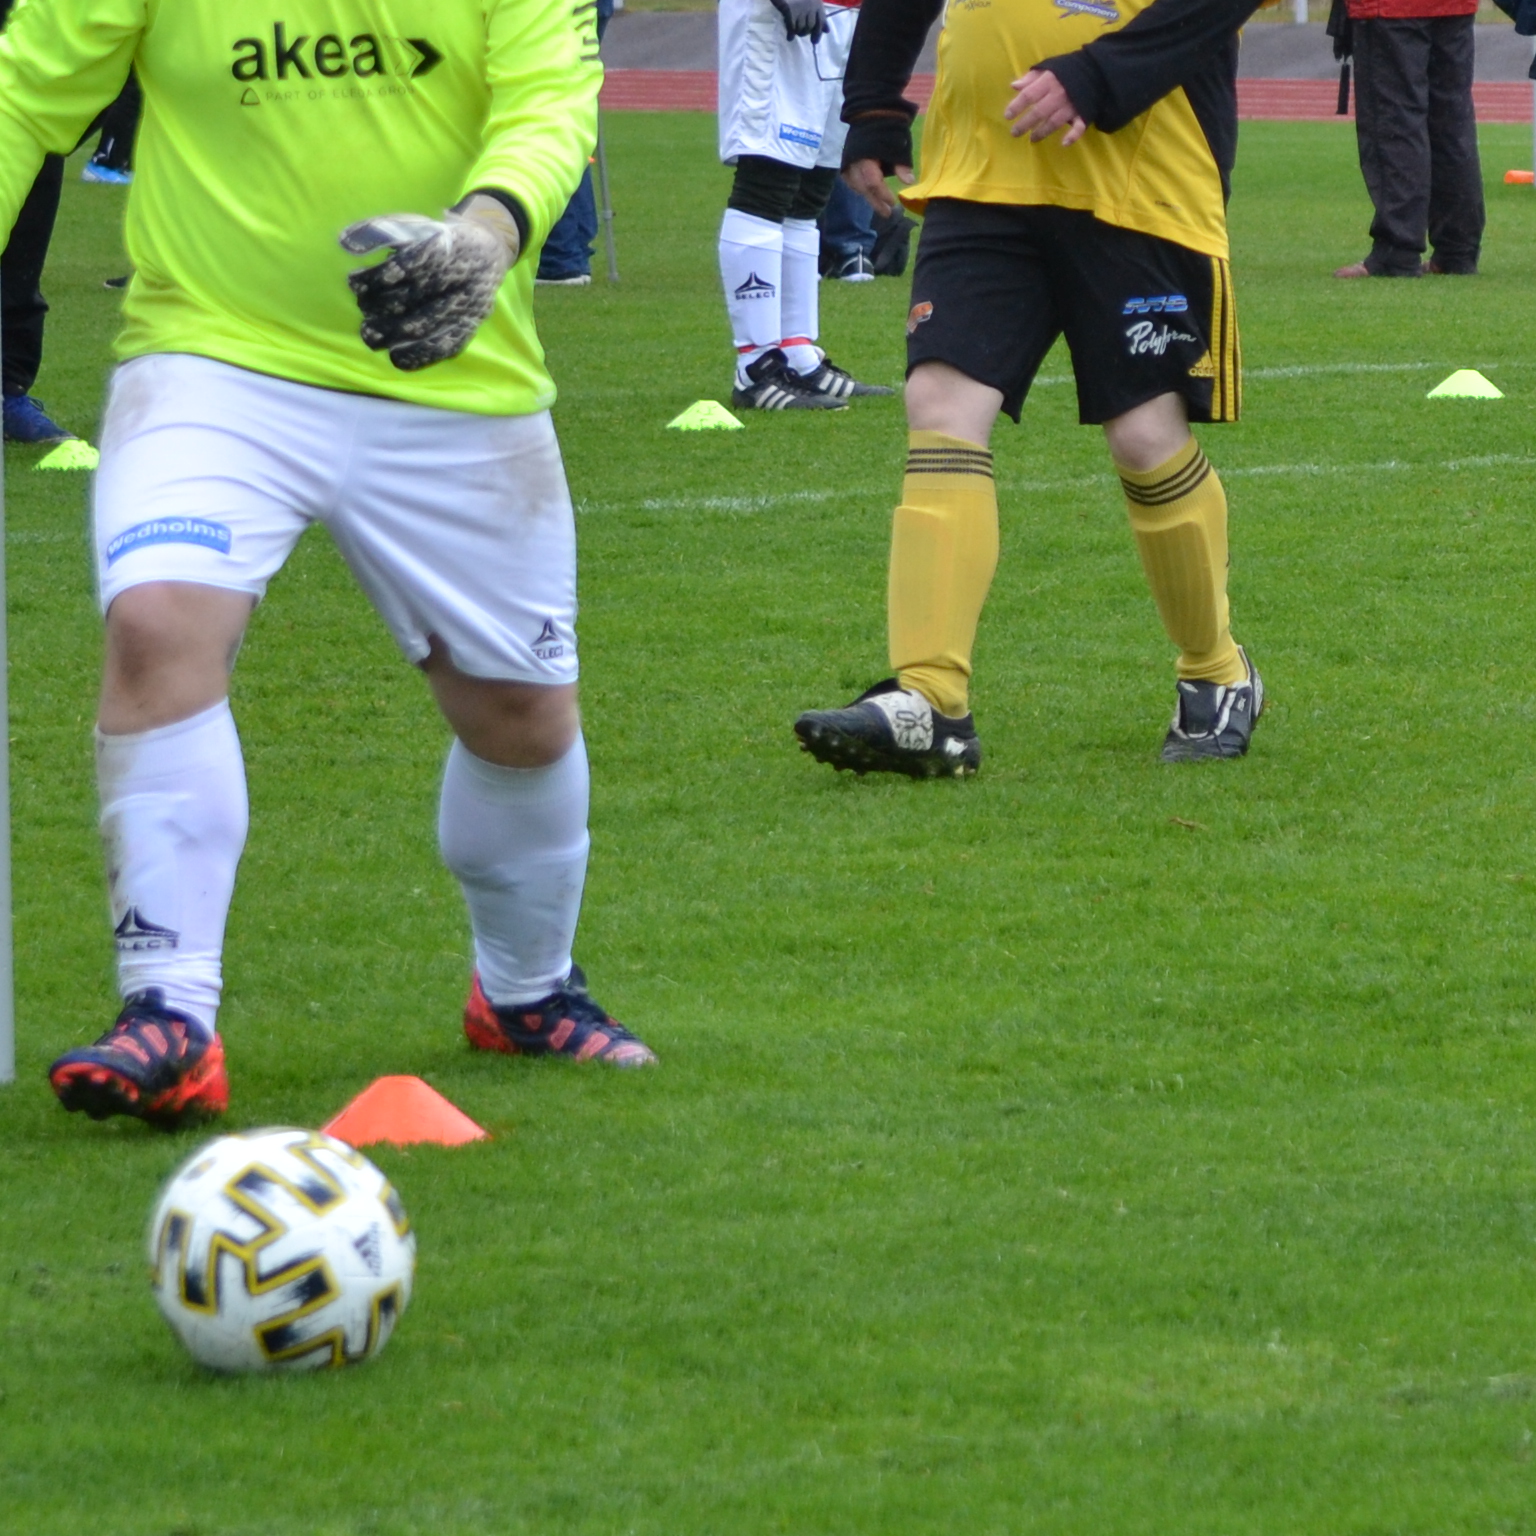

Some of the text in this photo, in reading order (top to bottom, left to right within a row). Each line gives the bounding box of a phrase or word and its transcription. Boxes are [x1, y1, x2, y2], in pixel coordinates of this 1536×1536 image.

[231, 21, 387, 82] akea
[735, 291, 775, 300] SELECT
[1126, 321, 1197, 355] Polyform
[108, 519, 230, 556] Wedholms
